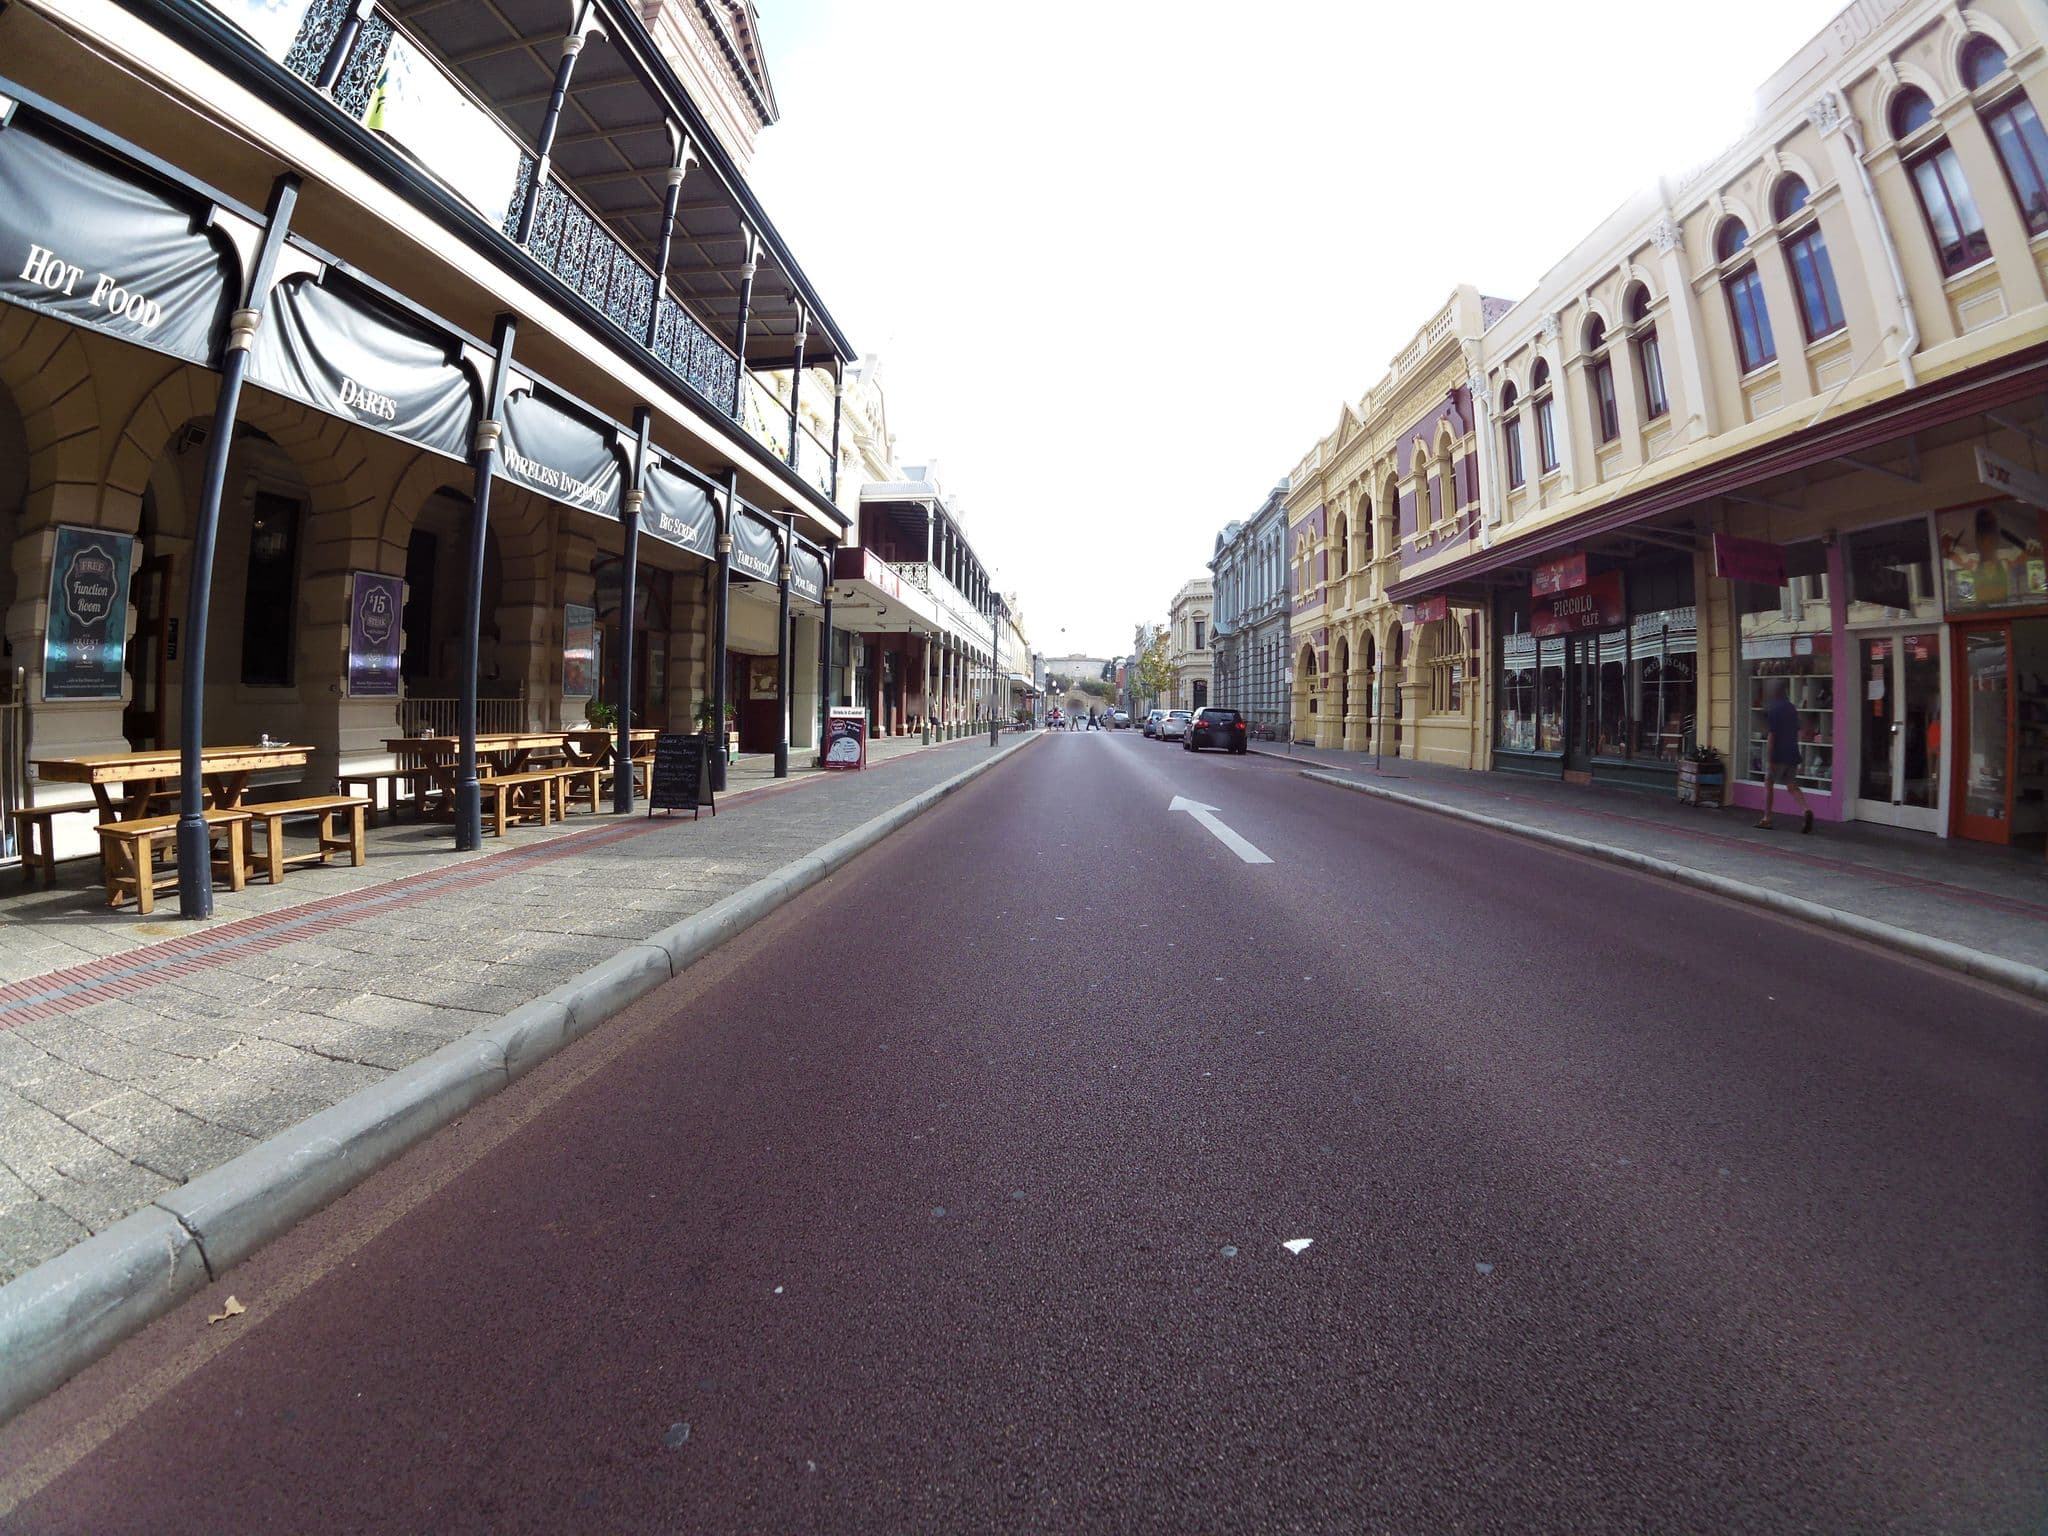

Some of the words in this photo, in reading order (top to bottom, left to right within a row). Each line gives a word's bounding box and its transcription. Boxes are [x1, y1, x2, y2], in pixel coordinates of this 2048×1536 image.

[19, 244, 84, 296] HOT
[88, 273, 160, 328] FOOD
[340, 377, 397, 420] DARTS
[504, 445, 560, 488] WIRELESS
[559, 471, 608, 506] INTERNET
[659, 512, 674, 532] BIG
[81, 560, 104, 573] FREE
[73, 580, 108, 597] Function
[78, 600, 101, 613] Room
[1553, 595, 1592, 617] PICCOLO
